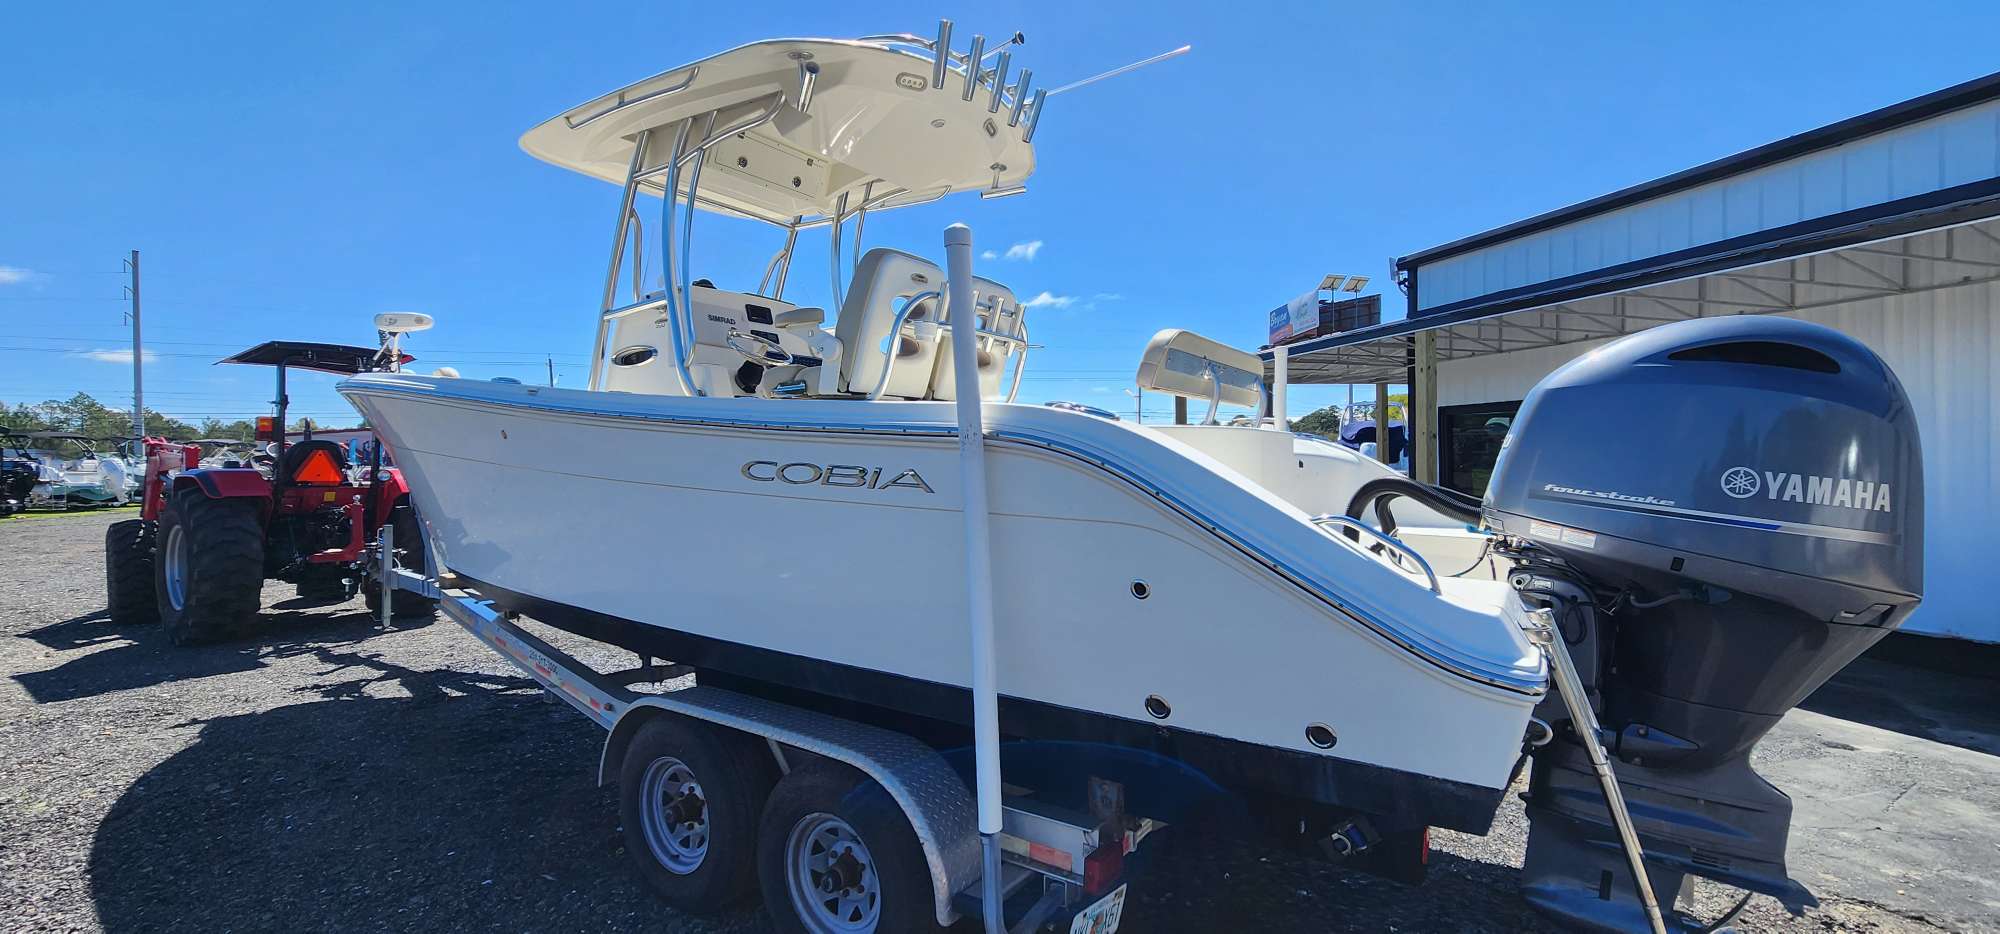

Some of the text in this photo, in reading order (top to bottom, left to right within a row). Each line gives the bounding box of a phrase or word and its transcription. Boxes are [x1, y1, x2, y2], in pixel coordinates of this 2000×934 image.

[707, 313, 736, 325] SIMRAD
[740, 460, 936, 494] COBIA
[1764, 471, 1891, 513] YAMAHA
